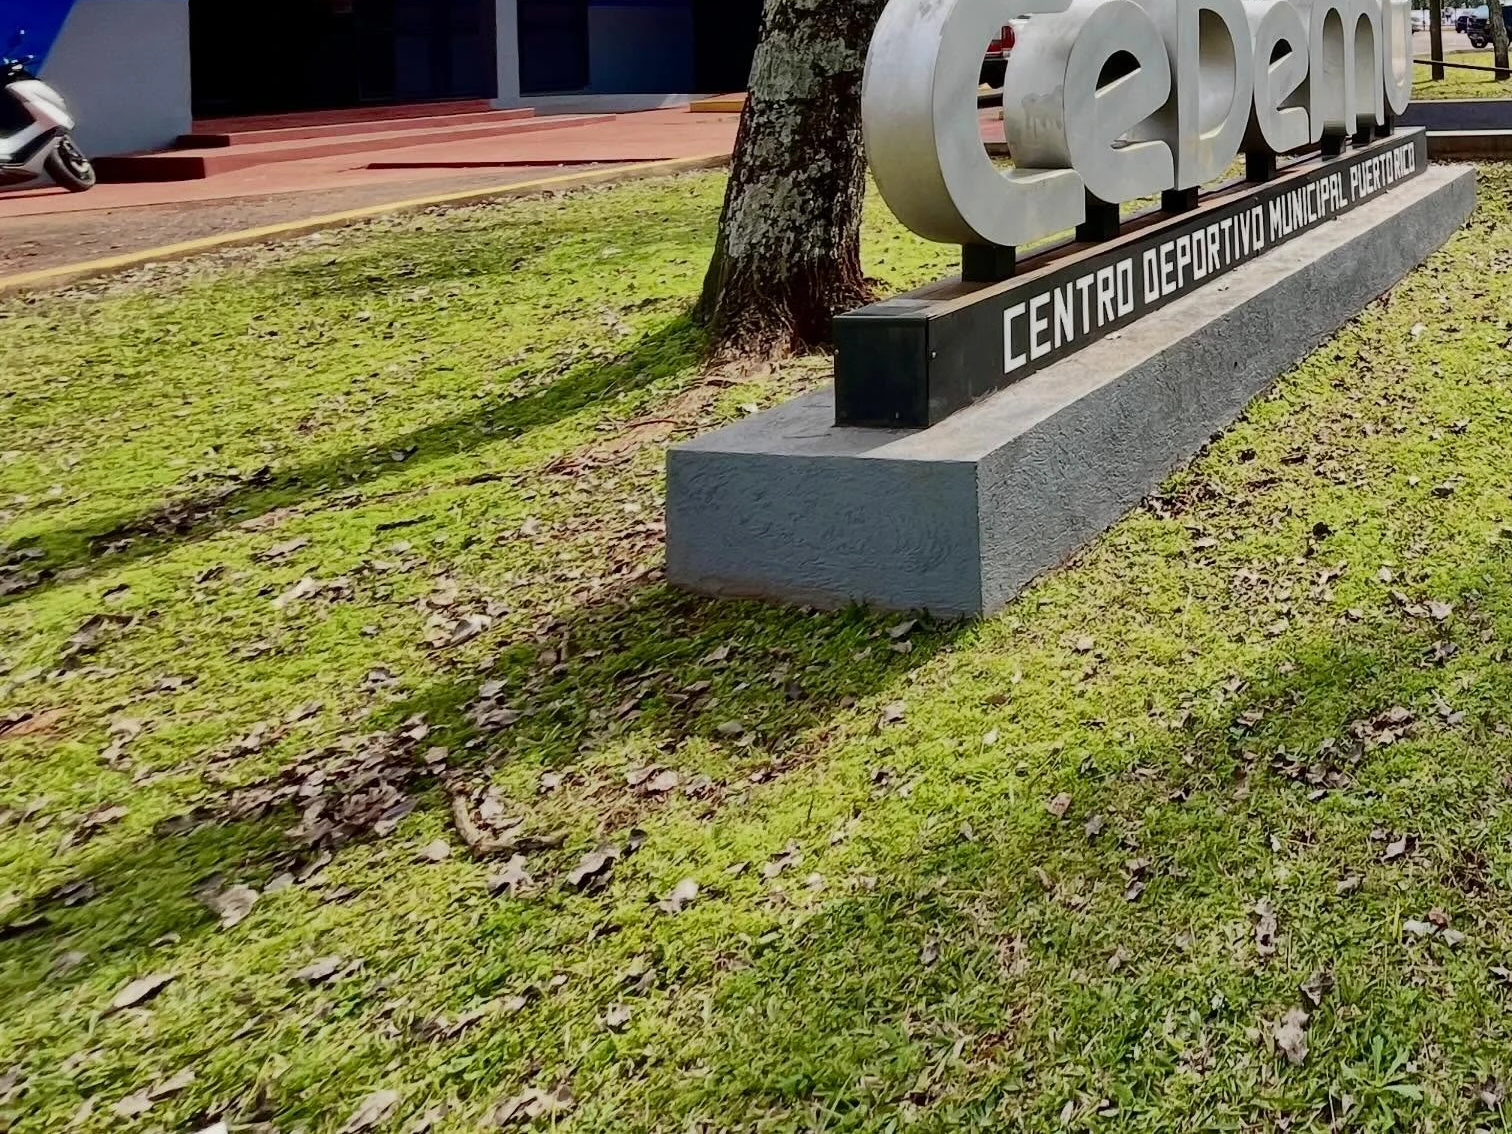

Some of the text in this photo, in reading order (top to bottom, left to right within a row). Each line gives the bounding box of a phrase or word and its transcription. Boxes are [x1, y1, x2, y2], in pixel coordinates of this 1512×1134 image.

[1003, 141, 1416, 374] CENTRO DEPORTIVO MUNICIPAL PUERTO RICO
